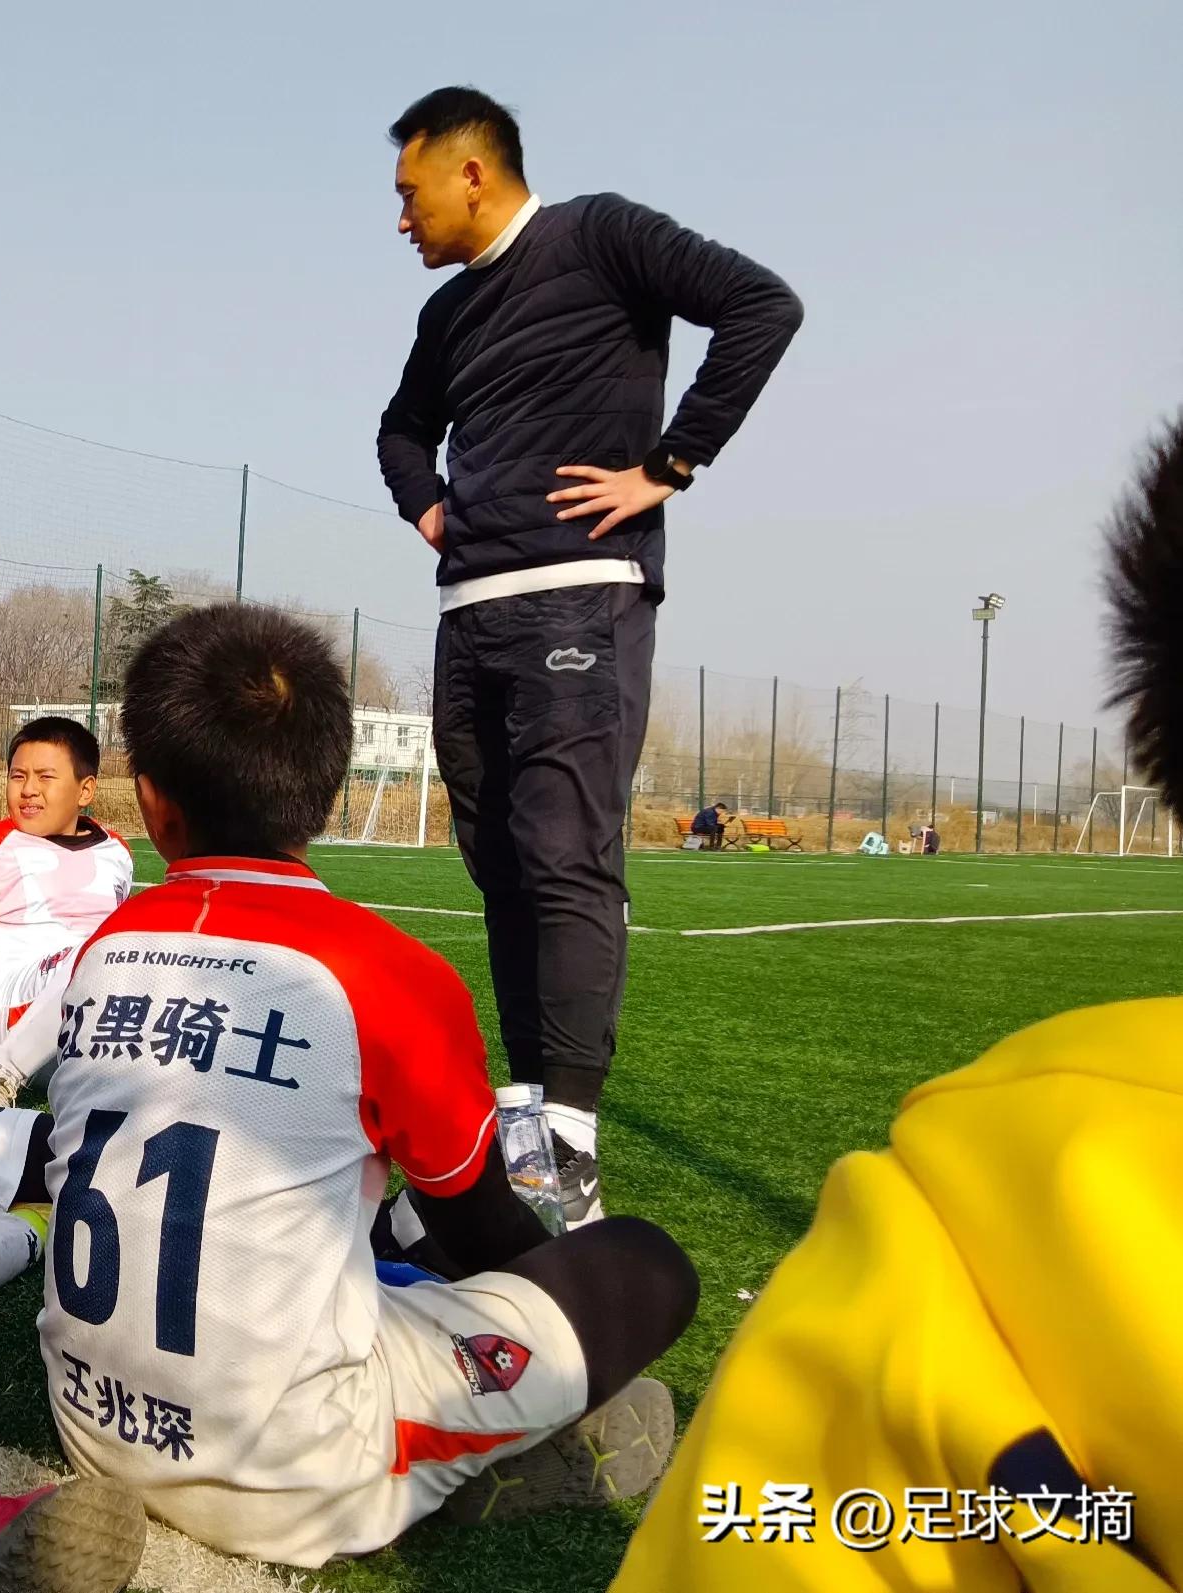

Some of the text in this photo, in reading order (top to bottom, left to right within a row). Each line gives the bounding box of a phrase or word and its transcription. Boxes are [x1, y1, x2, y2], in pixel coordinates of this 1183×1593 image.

[104, 950, 257, 976] R&B KNIGHTS-FC
[53, 1109, 220, 1357] 61
[62, 1349, 195, 1462] 王兆琛
